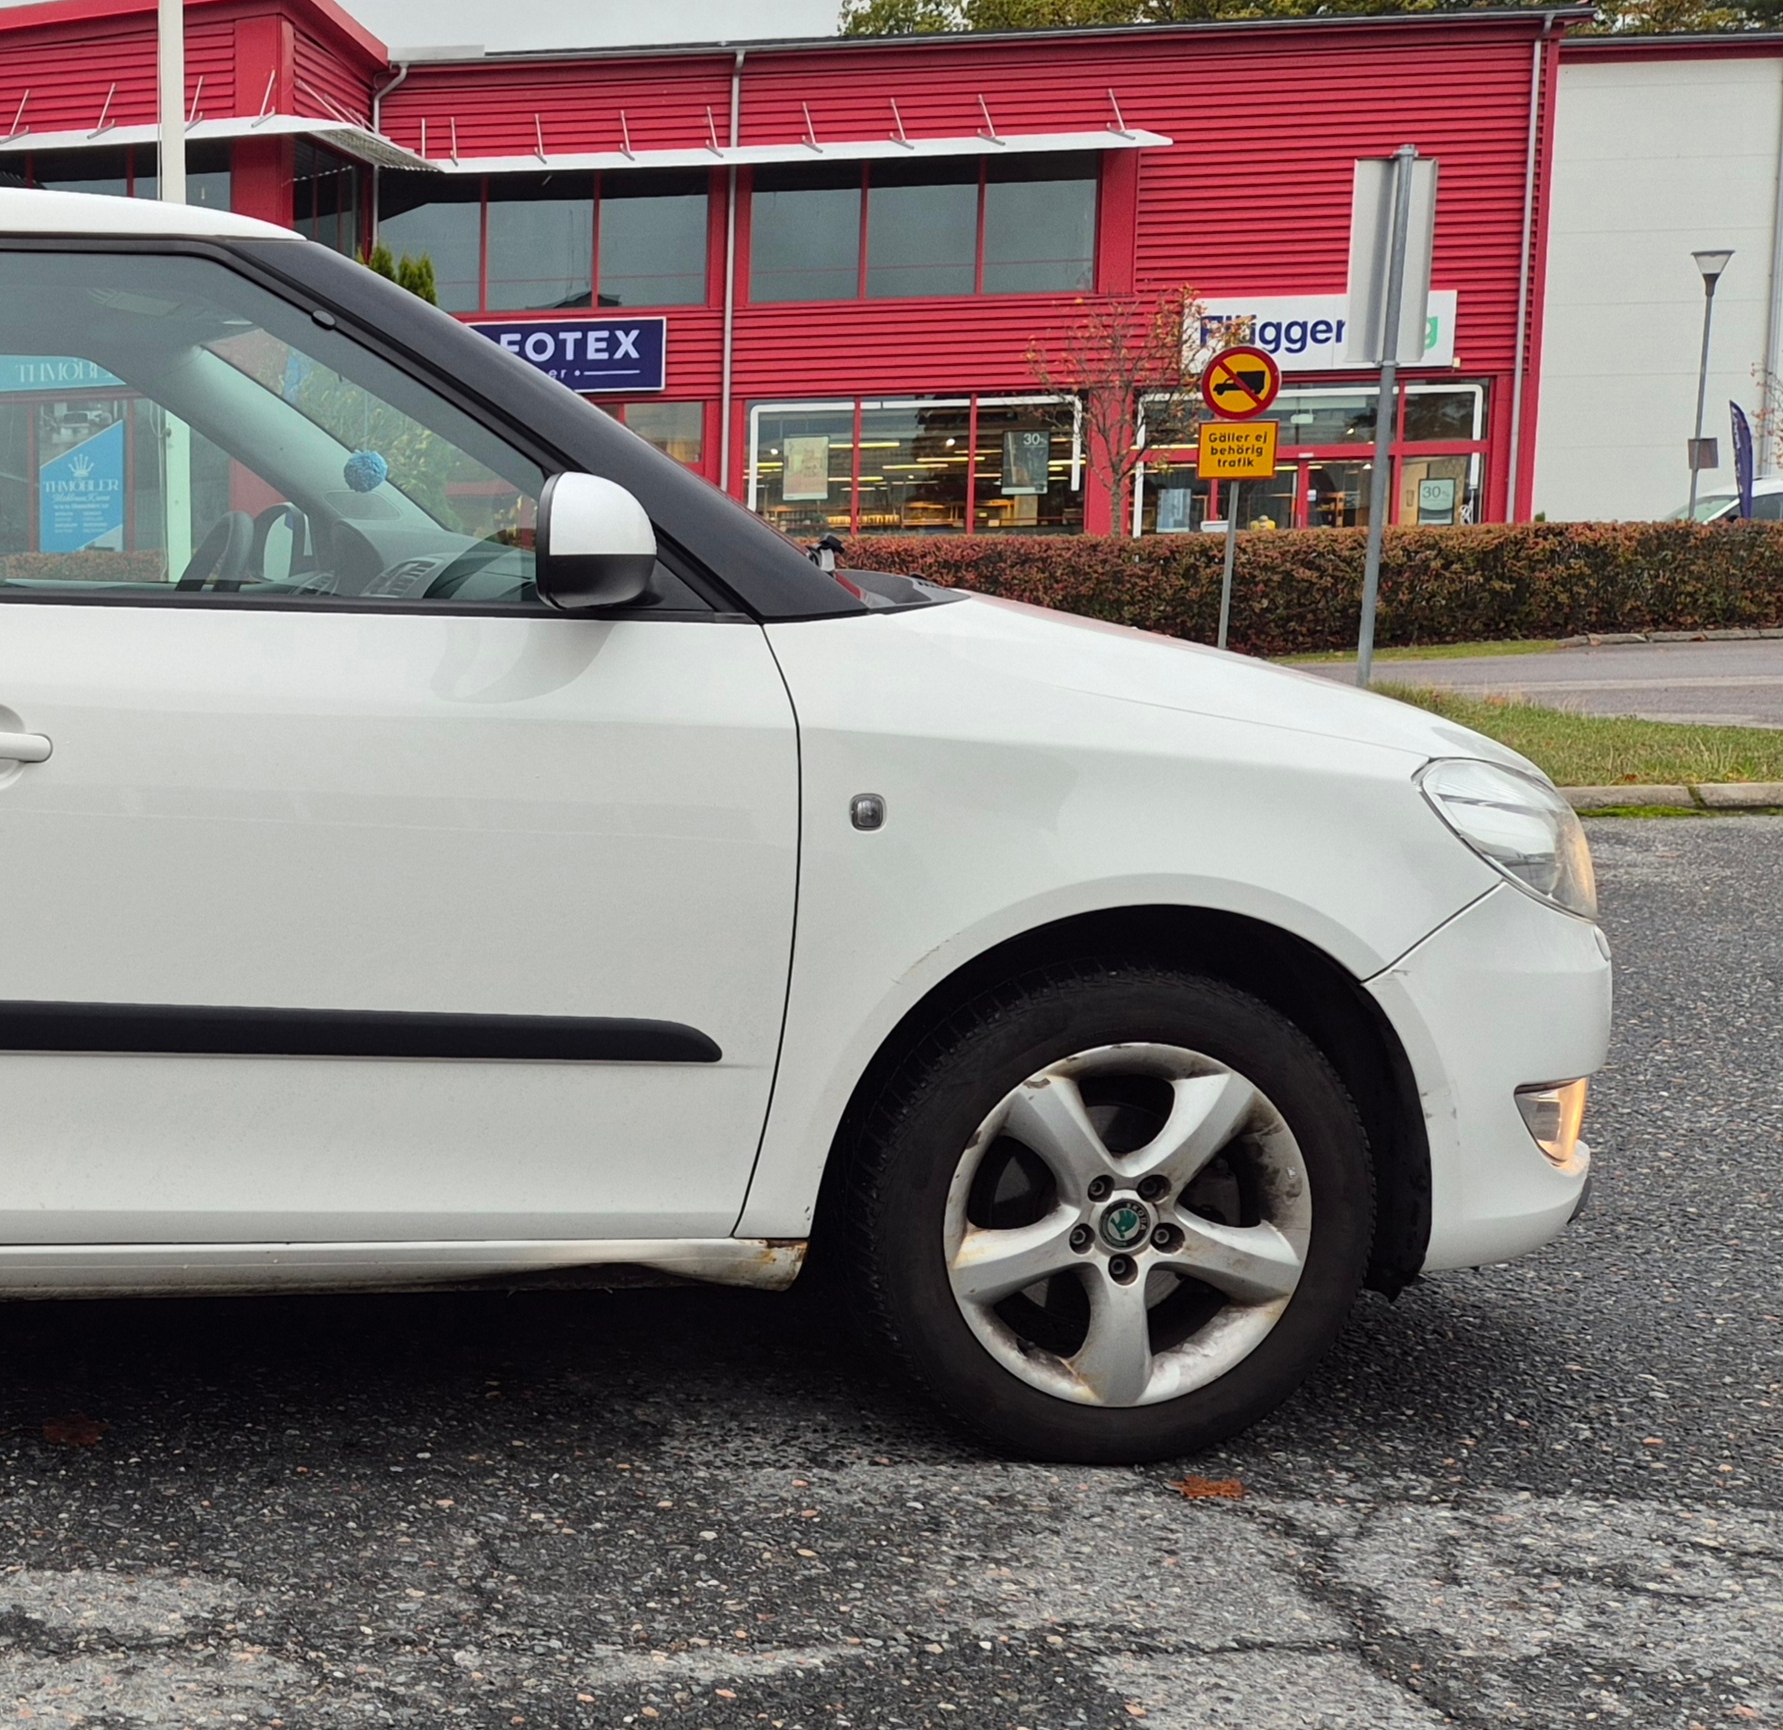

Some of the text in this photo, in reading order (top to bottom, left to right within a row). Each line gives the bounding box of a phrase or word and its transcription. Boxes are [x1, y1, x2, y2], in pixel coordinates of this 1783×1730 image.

[1208, 431, 1268, 444] Gäller ej
[1210, 444, 1264, 457] behörig
[1217, 457, 1255, 467] trafik
